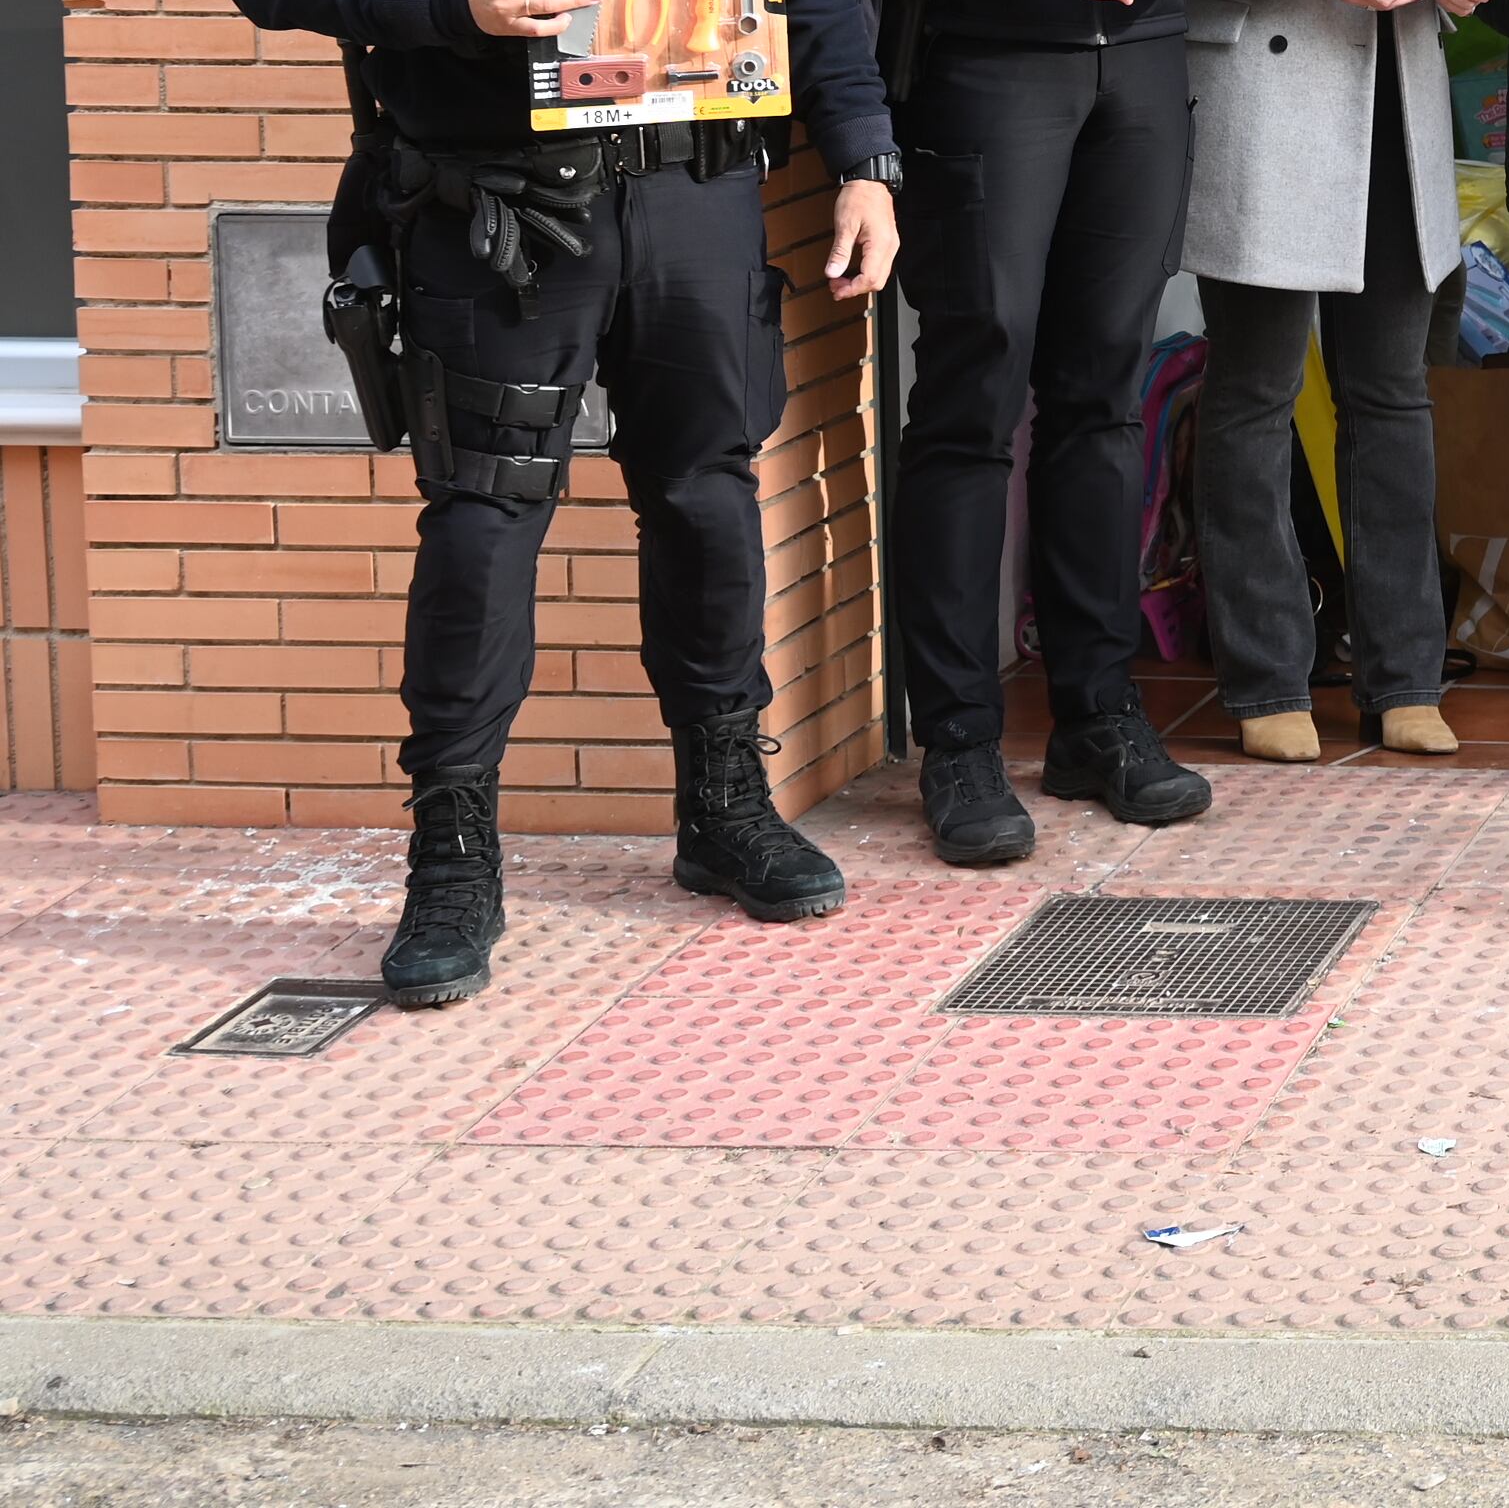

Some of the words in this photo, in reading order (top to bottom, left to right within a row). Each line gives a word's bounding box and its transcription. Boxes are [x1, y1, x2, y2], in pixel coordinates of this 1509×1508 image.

[730, 79, 776, 91] TOOL
[582, 108, 632, 125] 18M+
[245, 389, 361, 417] CONTA
